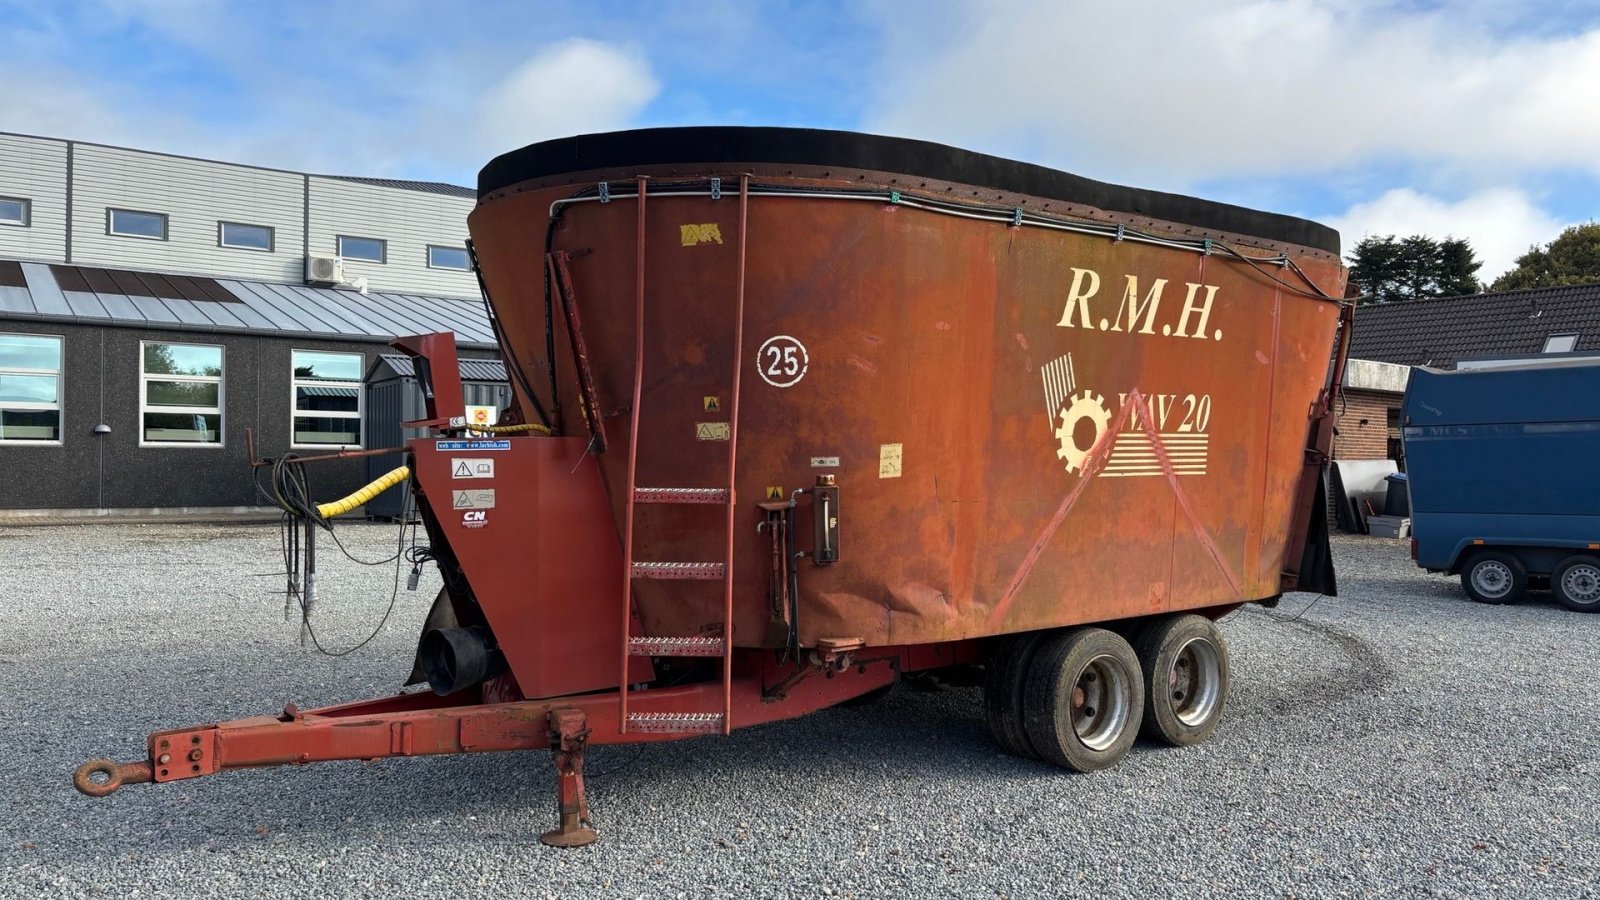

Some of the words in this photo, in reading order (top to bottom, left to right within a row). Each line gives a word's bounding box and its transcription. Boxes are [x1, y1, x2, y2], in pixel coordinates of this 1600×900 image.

[1056, 267, 1222, 341] R.M.H.
[767, 346, 798, 375] 25
[1177, 393, 1211, 433] 20
[463, 511, 486, 521] CN
